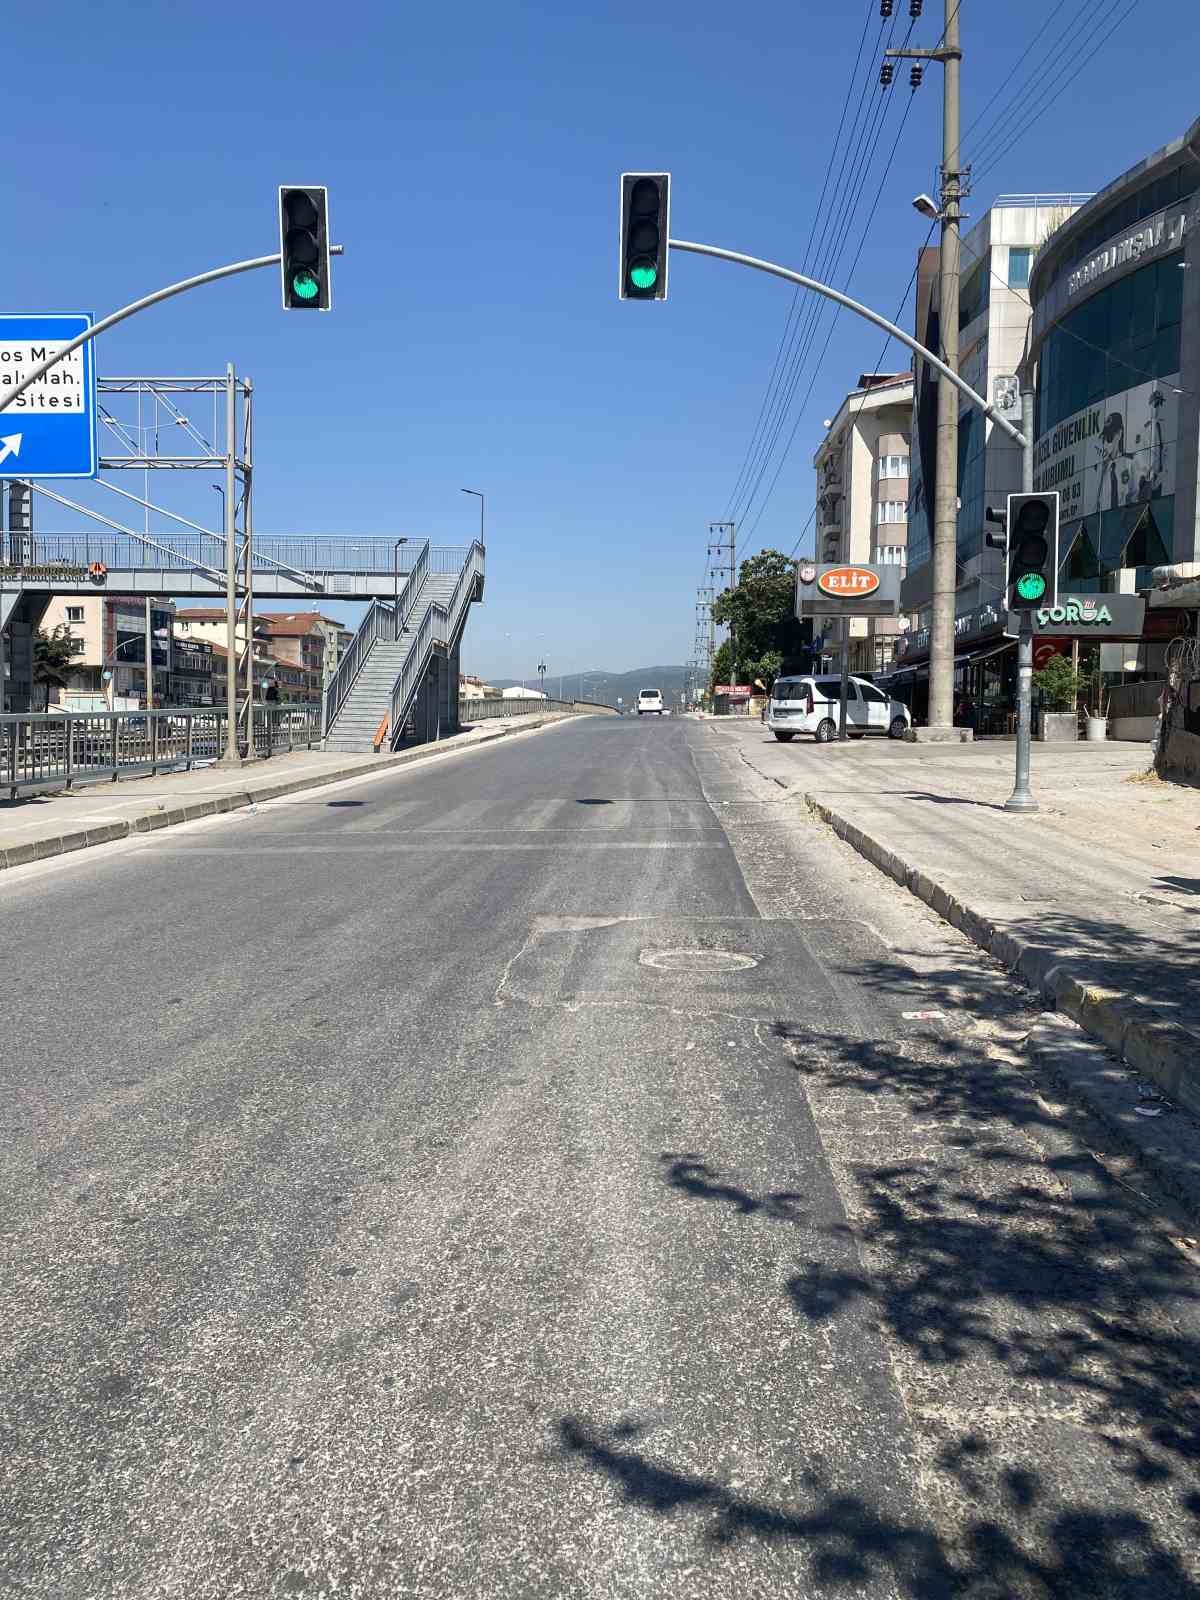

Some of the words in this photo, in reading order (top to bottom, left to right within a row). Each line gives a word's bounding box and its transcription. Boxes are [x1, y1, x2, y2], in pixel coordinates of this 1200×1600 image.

[33, 370, 80, 384] Mah.
[16, 392, 80, 407] Sitesi
[1053, 409, 1101, 454] GÜVENLİK
[827, 571, 870, 588] ELİT
